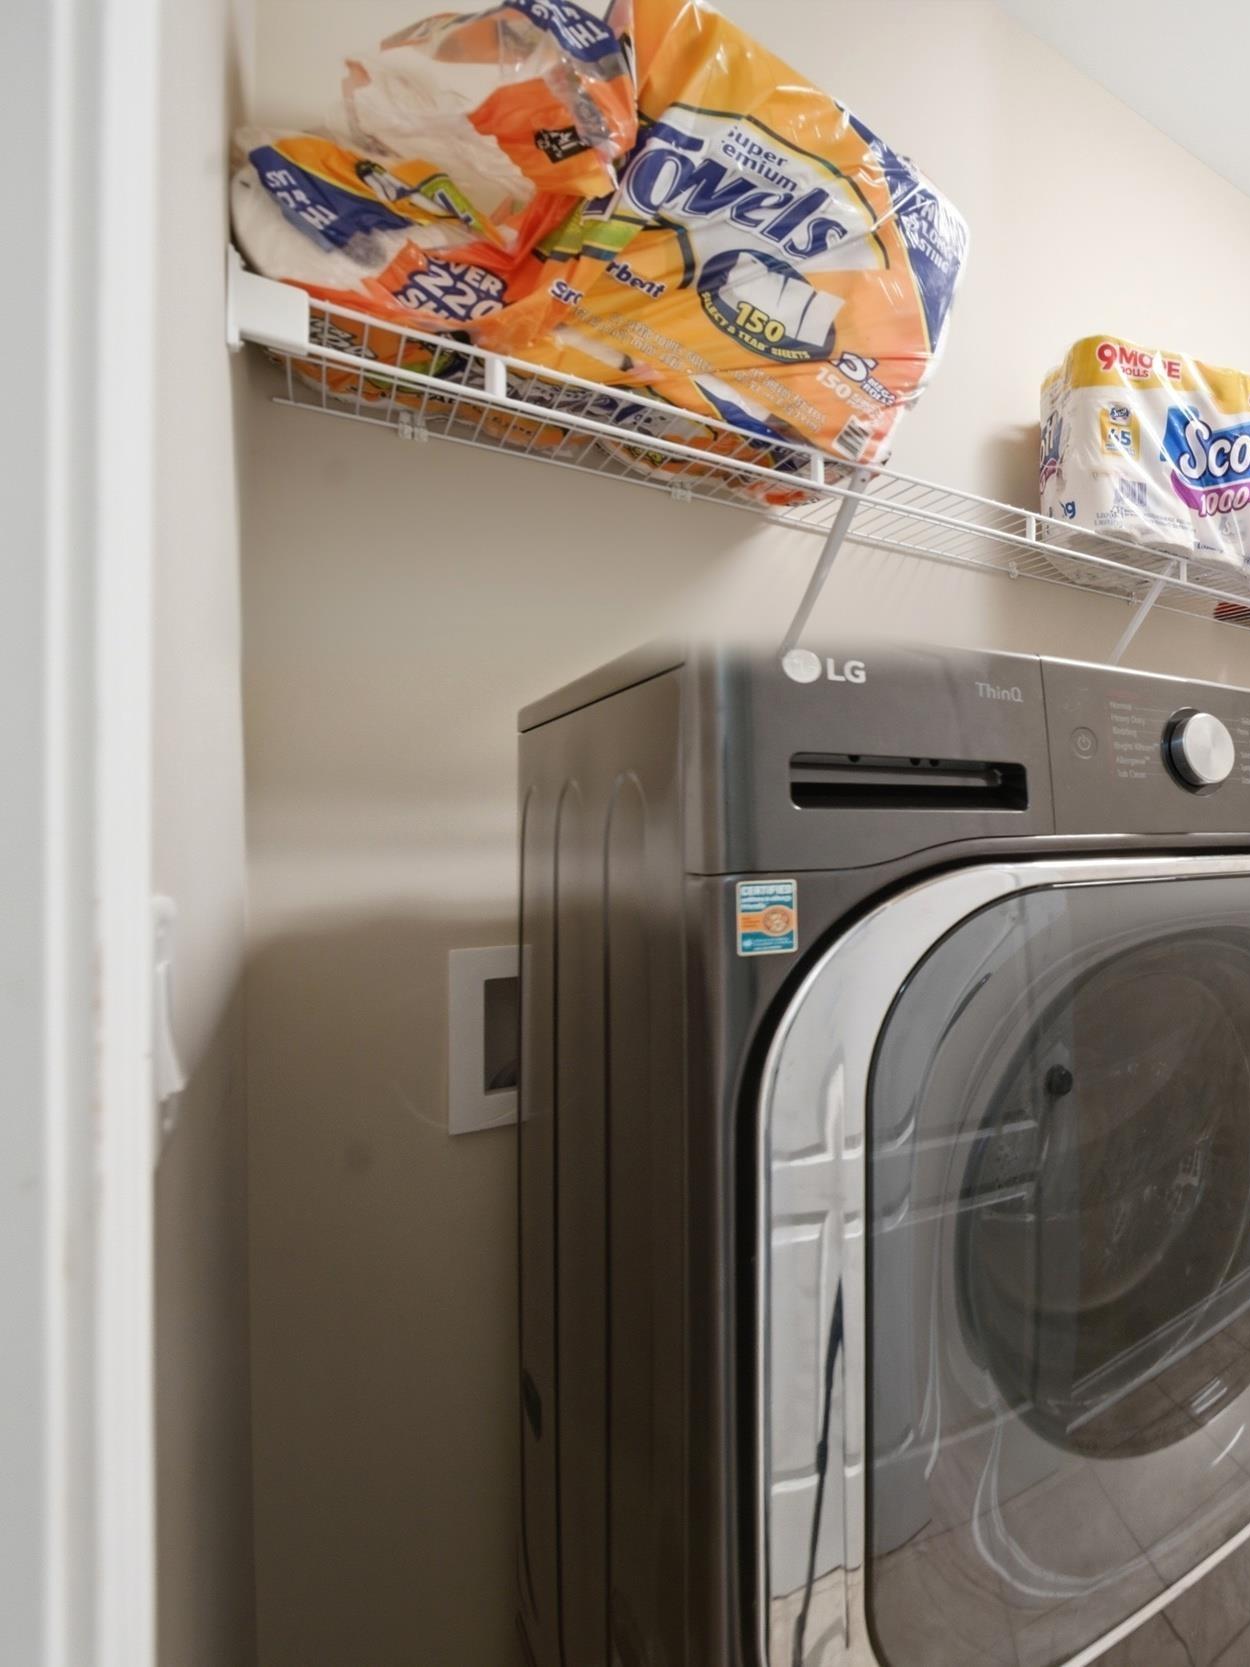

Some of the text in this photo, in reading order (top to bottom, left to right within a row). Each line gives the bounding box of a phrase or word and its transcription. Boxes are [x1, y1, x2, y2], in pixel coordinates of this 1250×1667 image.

[721, 140, 798, 192] emium
[735, 301, 785, 343] 150
[1097, 343, 1181, 379] 9 MOE
[1199, 486, 1250, 517] 1000
[826, 658, 867, 684] LG
[974, 681, 1024, 702] ThinQ
